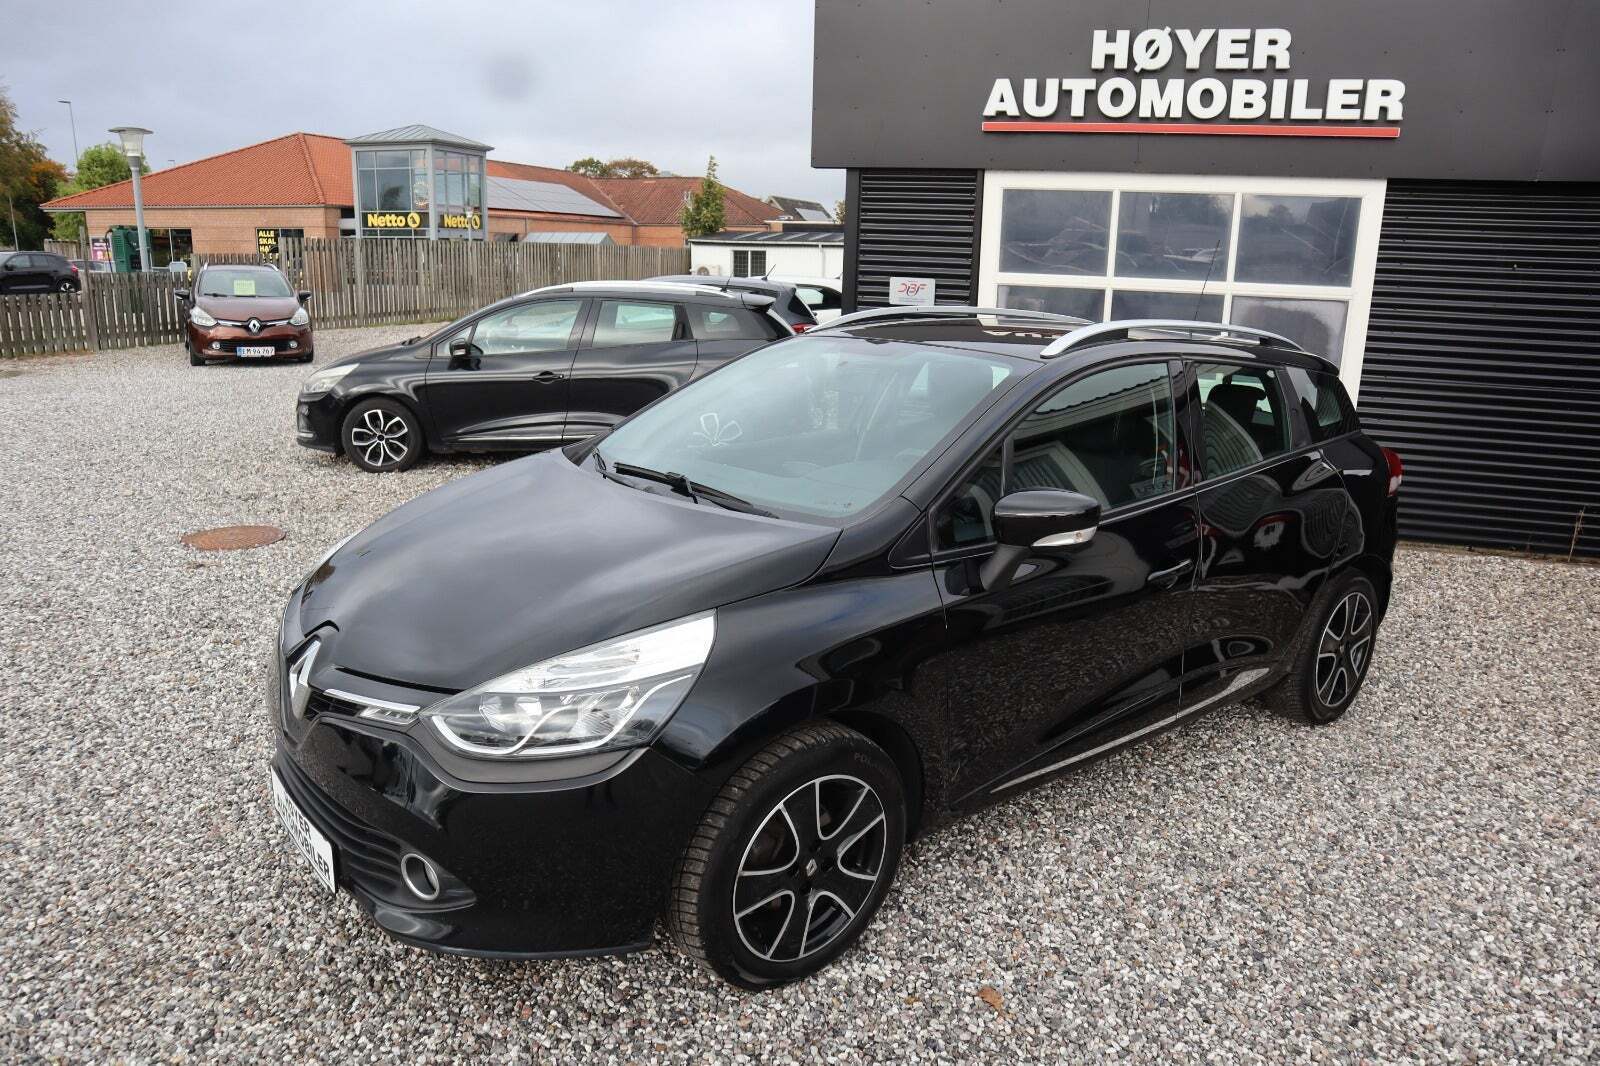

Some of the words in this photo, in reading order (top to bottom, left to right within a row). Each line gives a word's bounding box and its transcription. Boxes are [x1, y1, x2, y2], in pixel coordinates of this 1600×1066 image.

[1091, 26, 1292, 73] HØYER
[982, 77, 1406, 121] AUTOMOBILER
[367, 213, 406, 228] Netto
